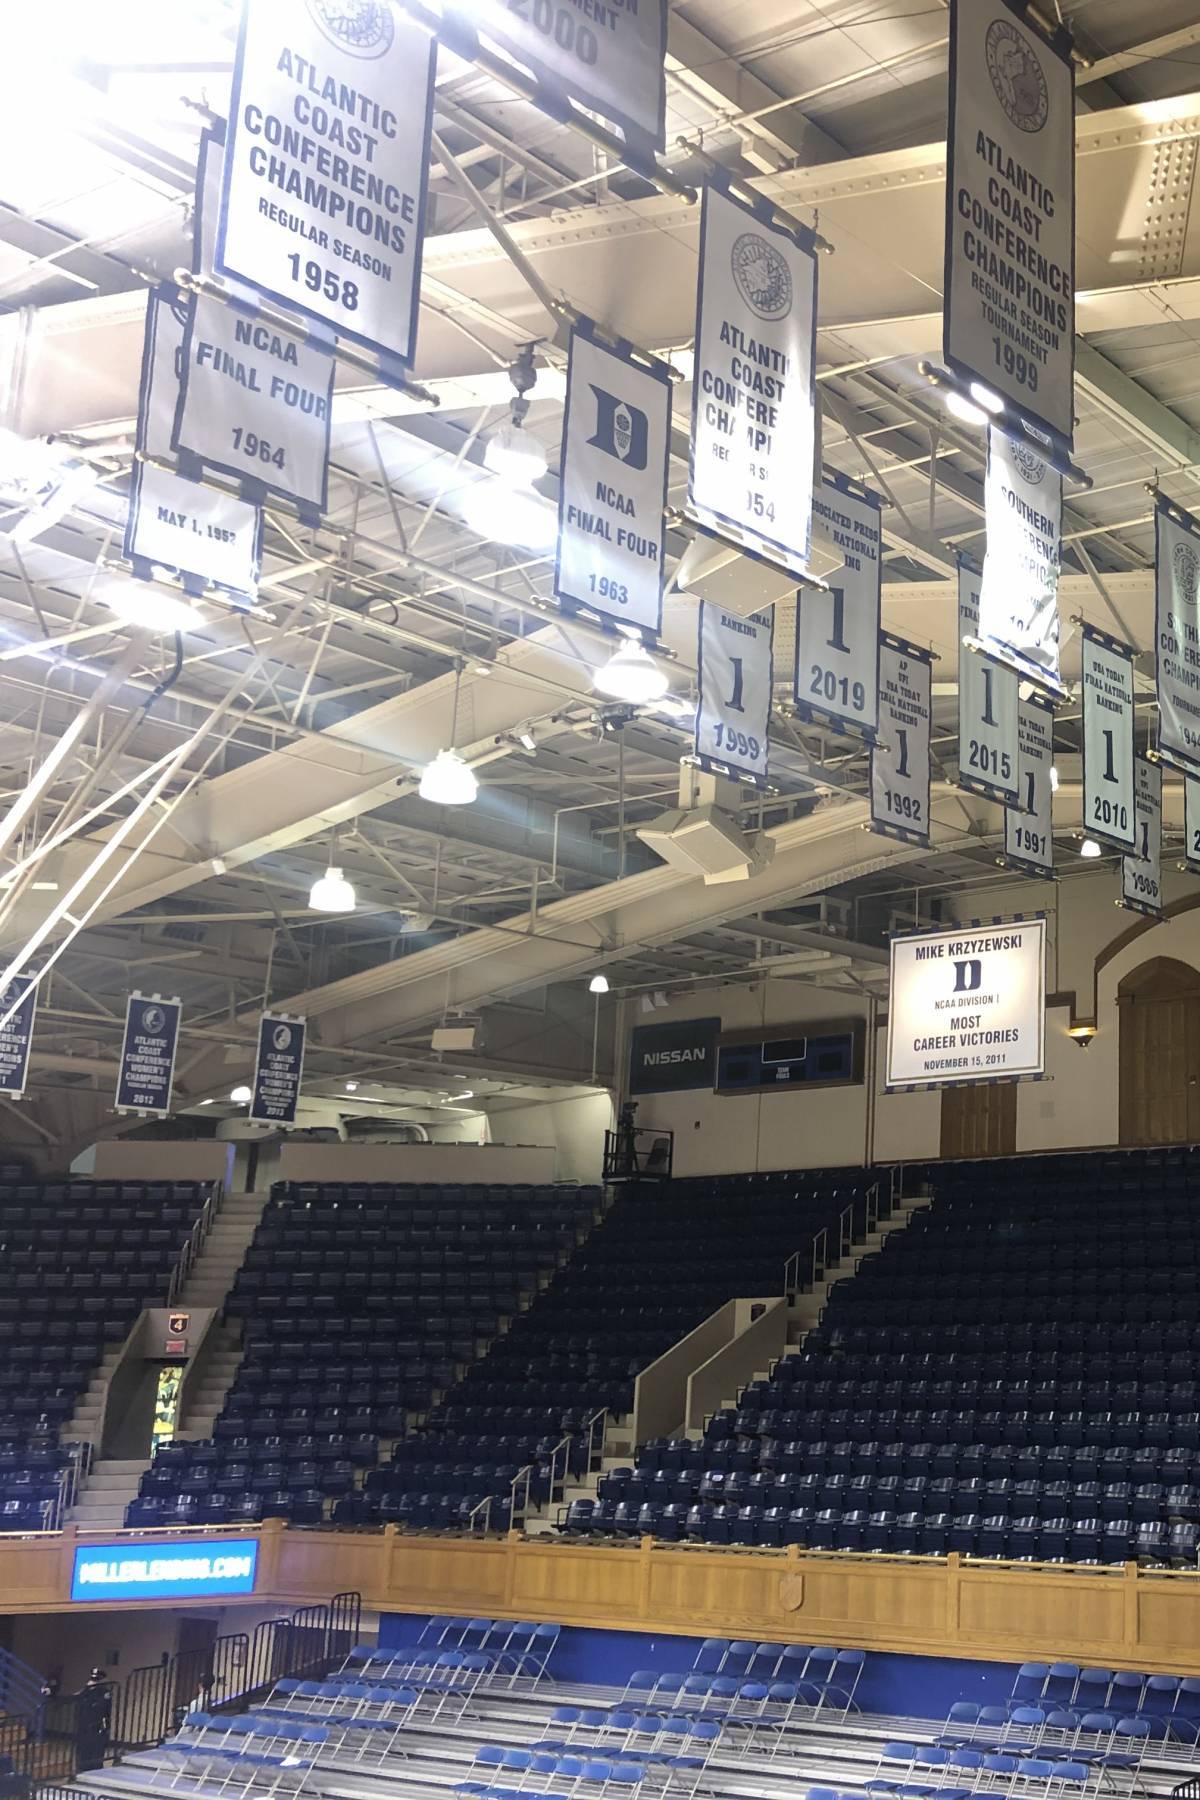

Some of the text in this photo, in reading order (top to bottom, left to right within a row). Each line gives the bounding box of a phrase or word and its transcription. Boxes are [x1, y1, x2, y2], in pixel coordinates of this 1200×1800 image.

[277, 47, 397, 139] ATLANTIC
[294, 95, 378, 162] COAST
[245, 104, 415, 224] CONFERENCE
[976, 129, 1055, 218] ATLANTIC
[250, 146, 406, 254] CHAMPIONS
[988, 177, 1042, 243] COAST
[259, 197, 392, 281] REGULAR SEASON
[958, 188, 1071, 300] CONFERENCE
[288, 253, 359, 311] 1958
[964, 230, 1066, 333] CHAMPIONS
[971, 270, 1059, 350] REGULAR SEASON
[235, 319, 298, 366] NCAA
[720, 321, 790, 376] ATLANTI
[981, 301, 1049, 364] TOURNAMENT
[197, 342, 326, 421] FINAL FOUR
[731, 357, 785, 402] COAST
[992, 337, 1038, 393] 1999
[702, 370, 778, 428] CONFERE
[232, 427, 286, 470] 1964
[158, 506, 187, 529] MAY
[192, 519, 202, 536] 1,
[596, 481, 635, 518] NCAA
[567, 505, 658, 561] FINAL FOUR
[833, 530, 877, 560] NATIONAL
[854, 520, 879, 543] PRESS
[589, 573, 628, 604] 1963
[721, 615, 757, 638] RANKING
[827, 587, 850, 655] 1
[724, 657, 744, 713] 1
[811, 664, 866, 712] 2019
[886, 680, 898, 693] USA
[1085, 673, 1131, 704] FINAL NATIONAL
[1093, 661, 1124, 685] USA TODAY
[981, 668, 999, 727] 1
[1096, 694, 1122, 715] RANKING
[713, 723, 760, 761] 1999
[895, 729, 911, 778] 1
[969, 740, 1011, 780] 2015
[1102, 730, 1119, 784] 1
[884, 791, 921, 821] 1992
[1025, 772, 1038, 816] 1
[1094, 796, 1128, 830] 2010
[1015, 827, 1046, 856] 1991
[1140, 822, 1151, 863] 1
[1132, 872, 1158, 898] 1986
[915, 935, 1022, 960] MIKE KRZYZEWSKI
[935, 1000, 956, 1010] NCAA
[958, 995, 993, 1007] DIVISION
[950, 1015, 981, 1031] MOST
[643, 1047, 706, 1066] NISSAN
[913, 1028, 1019, 1052] CAREER VICTORIES
[924, 1053, 1006, 1071] NOVEMBER 15, 2011
[173, 1320, 183, 1331] 4
